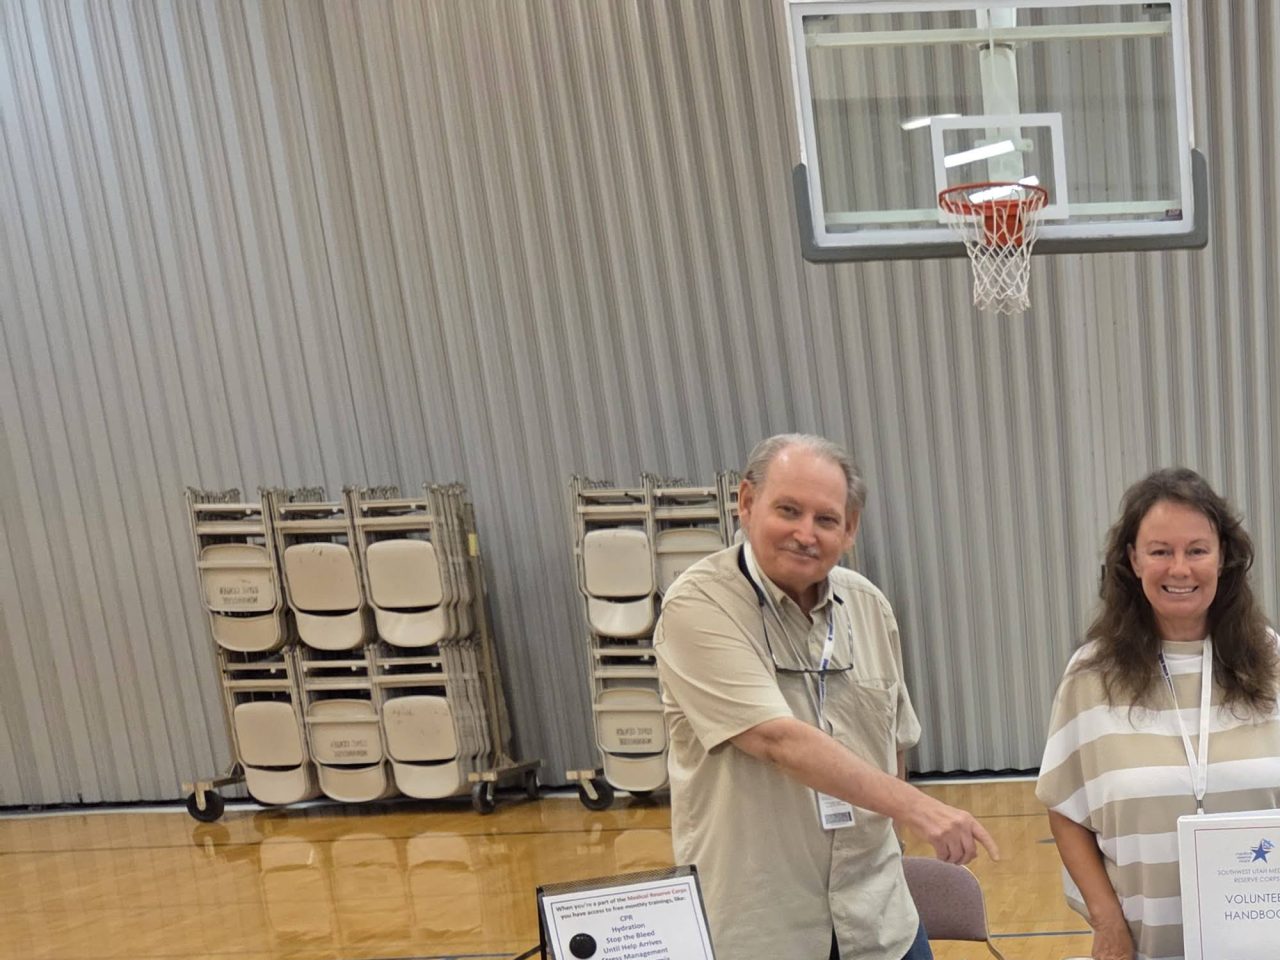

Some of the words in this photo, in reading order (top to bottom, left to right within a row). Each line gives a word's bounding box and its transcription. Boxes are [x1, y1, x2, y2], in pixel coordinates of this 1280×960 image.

[1217, 868, 1251, 876] SOUTHWEST
[620, 914, 634, 922] CPR
[612, 923, 646, 934] Hydration
[606, 936, 622, 944] Stop
[636, 930, 656, 939] Bleed
[603, 945, 621, 954] Until
[622, 943, 638, 951] Help
[639, 939, 662, 948] Arrives
[624, 947, 668, 960] Management
